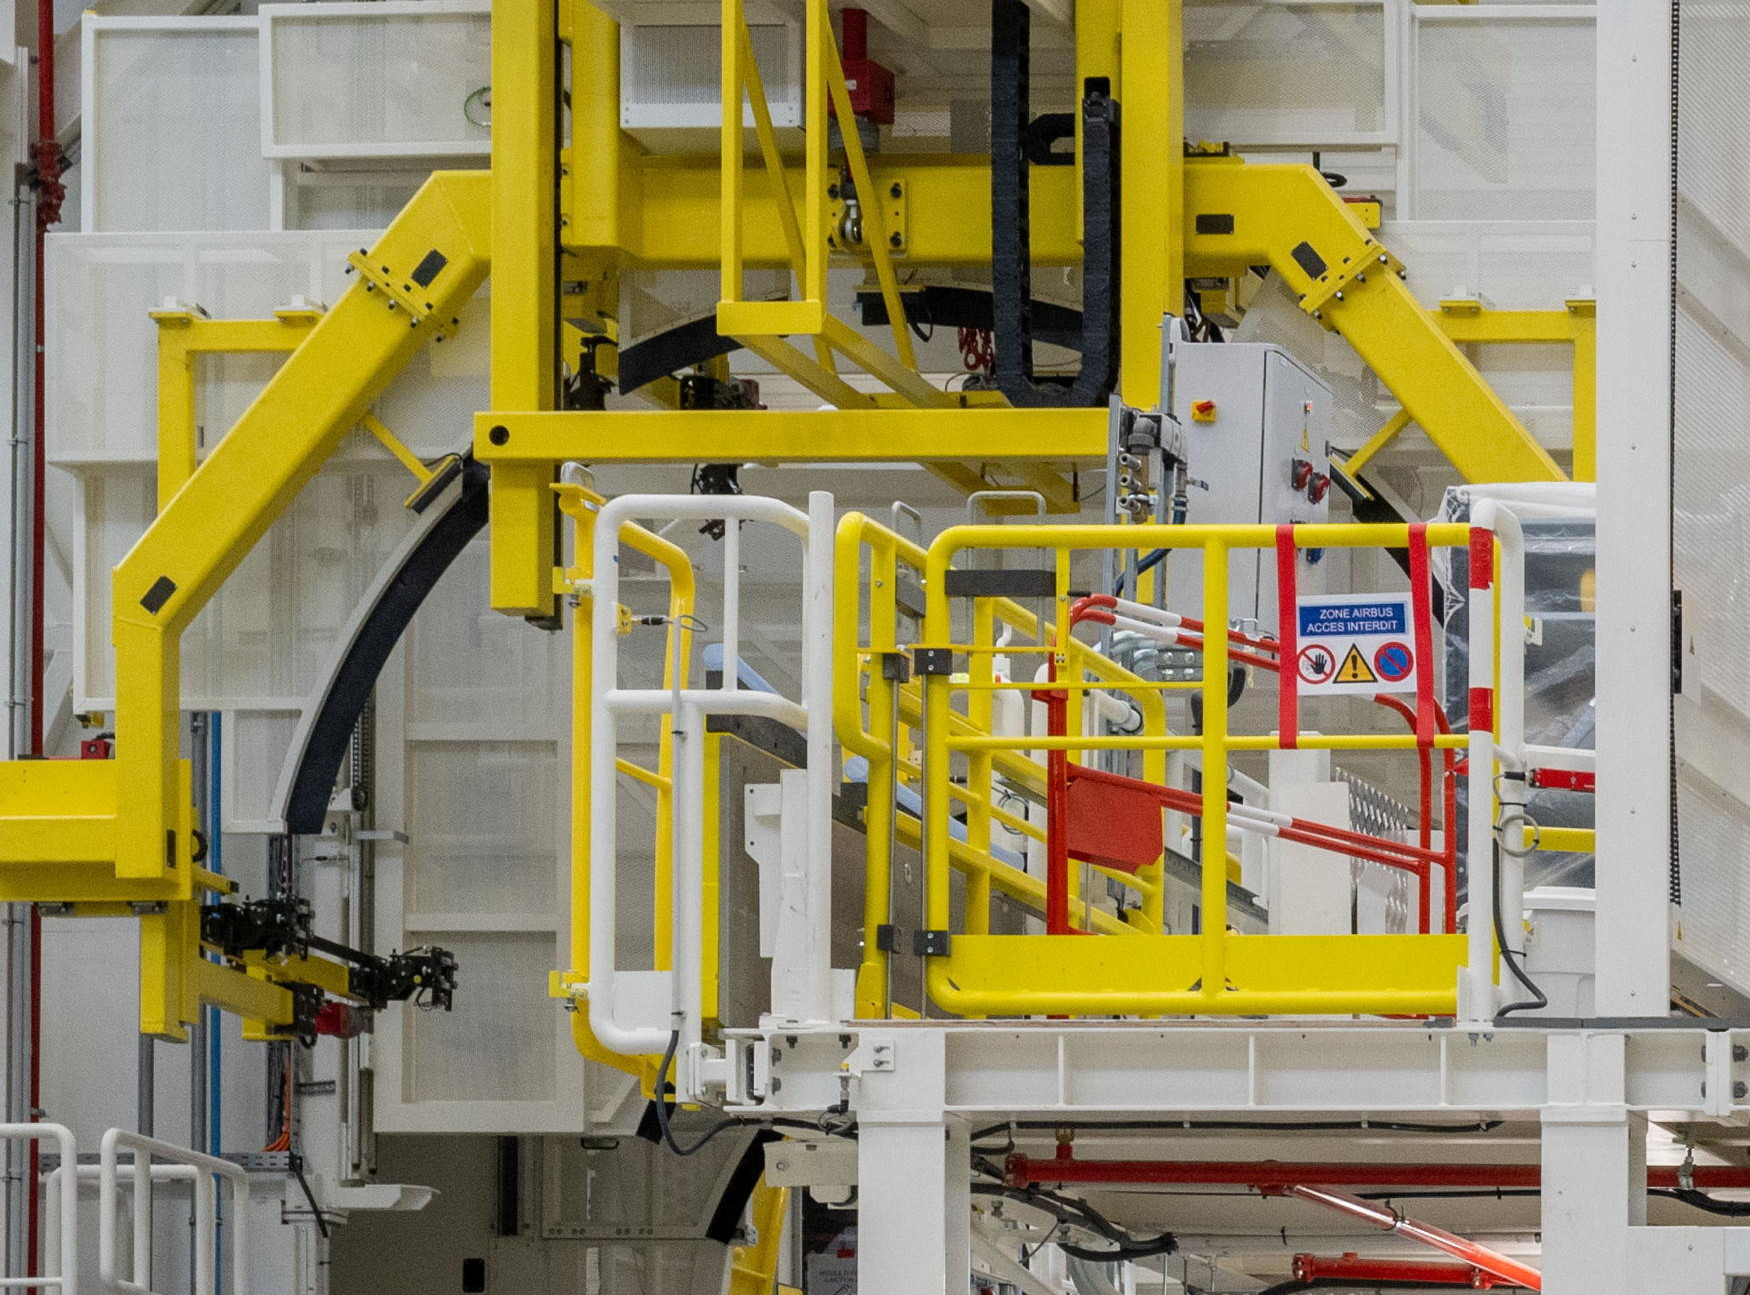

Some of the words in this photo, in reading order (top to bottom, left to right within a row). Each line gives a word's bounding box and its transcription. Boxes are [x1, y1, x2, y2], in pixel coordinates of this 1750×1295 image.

[1319, 609, 1351, 620] ZONE
[1352, 607, 1394, 618] AIRBUS
[1306, 621, 1345, 633] ACCES
[1347, 620, 1398, 631] INTERDIT
